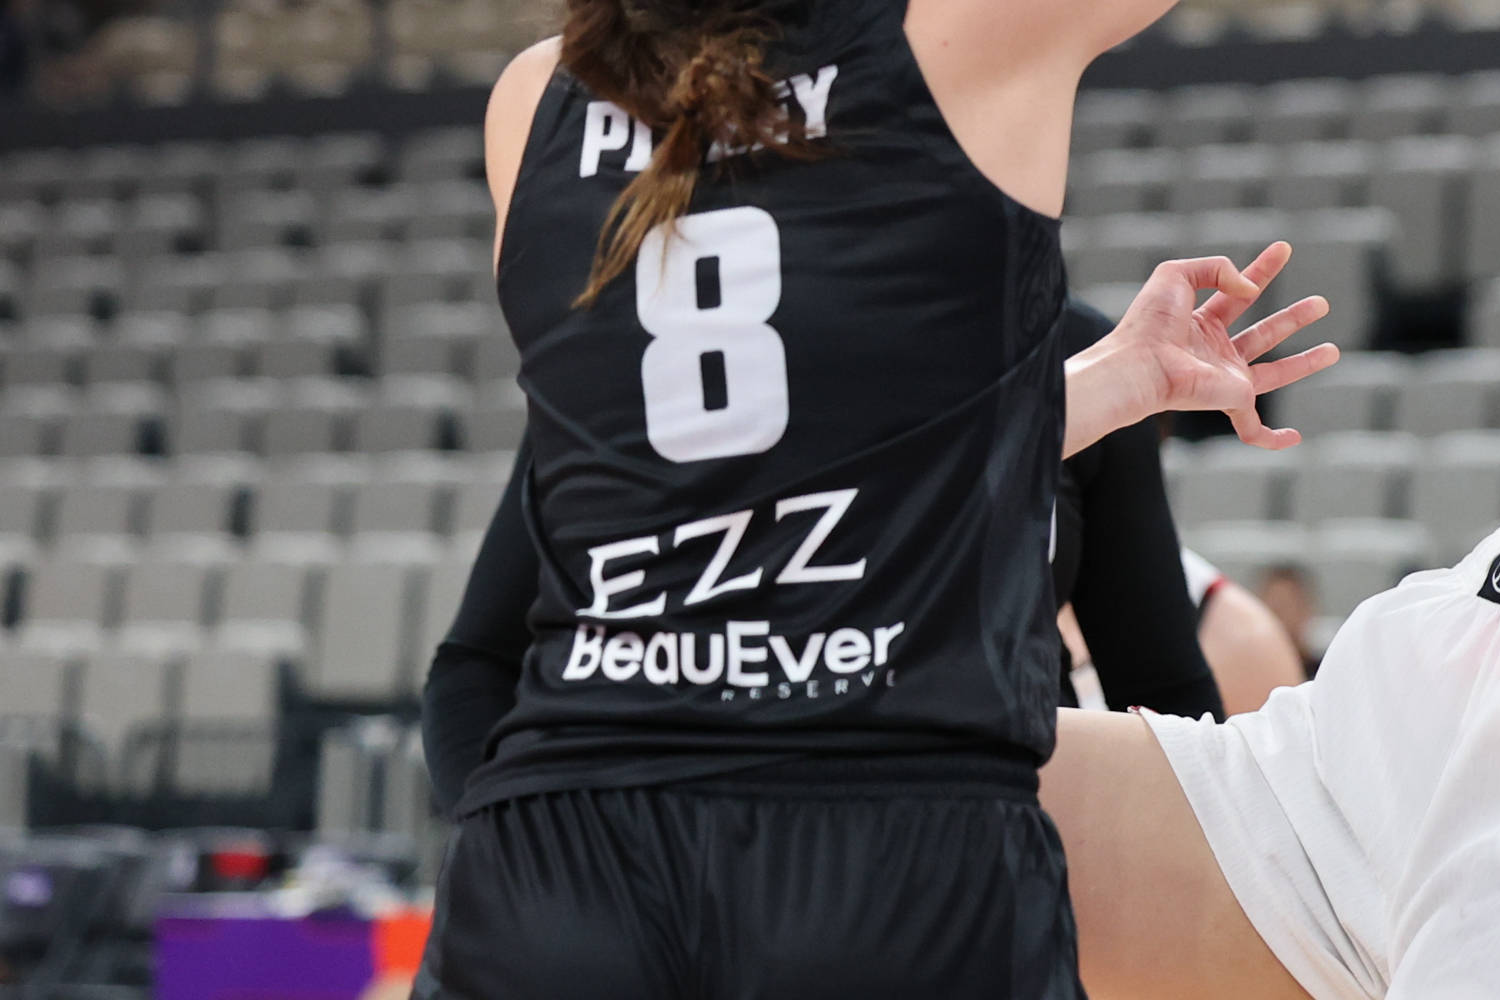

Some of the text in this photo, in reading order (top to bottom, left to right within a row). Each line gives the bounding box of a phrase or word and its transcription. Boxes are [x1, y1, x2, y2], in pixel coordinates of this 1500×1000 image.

[635, 205, 790, 464] 8
[575, 488, 868, 619] EZZ
[562, 621, 905, 687] BeauEver
[720, 669, 897, 702] RESERVE
